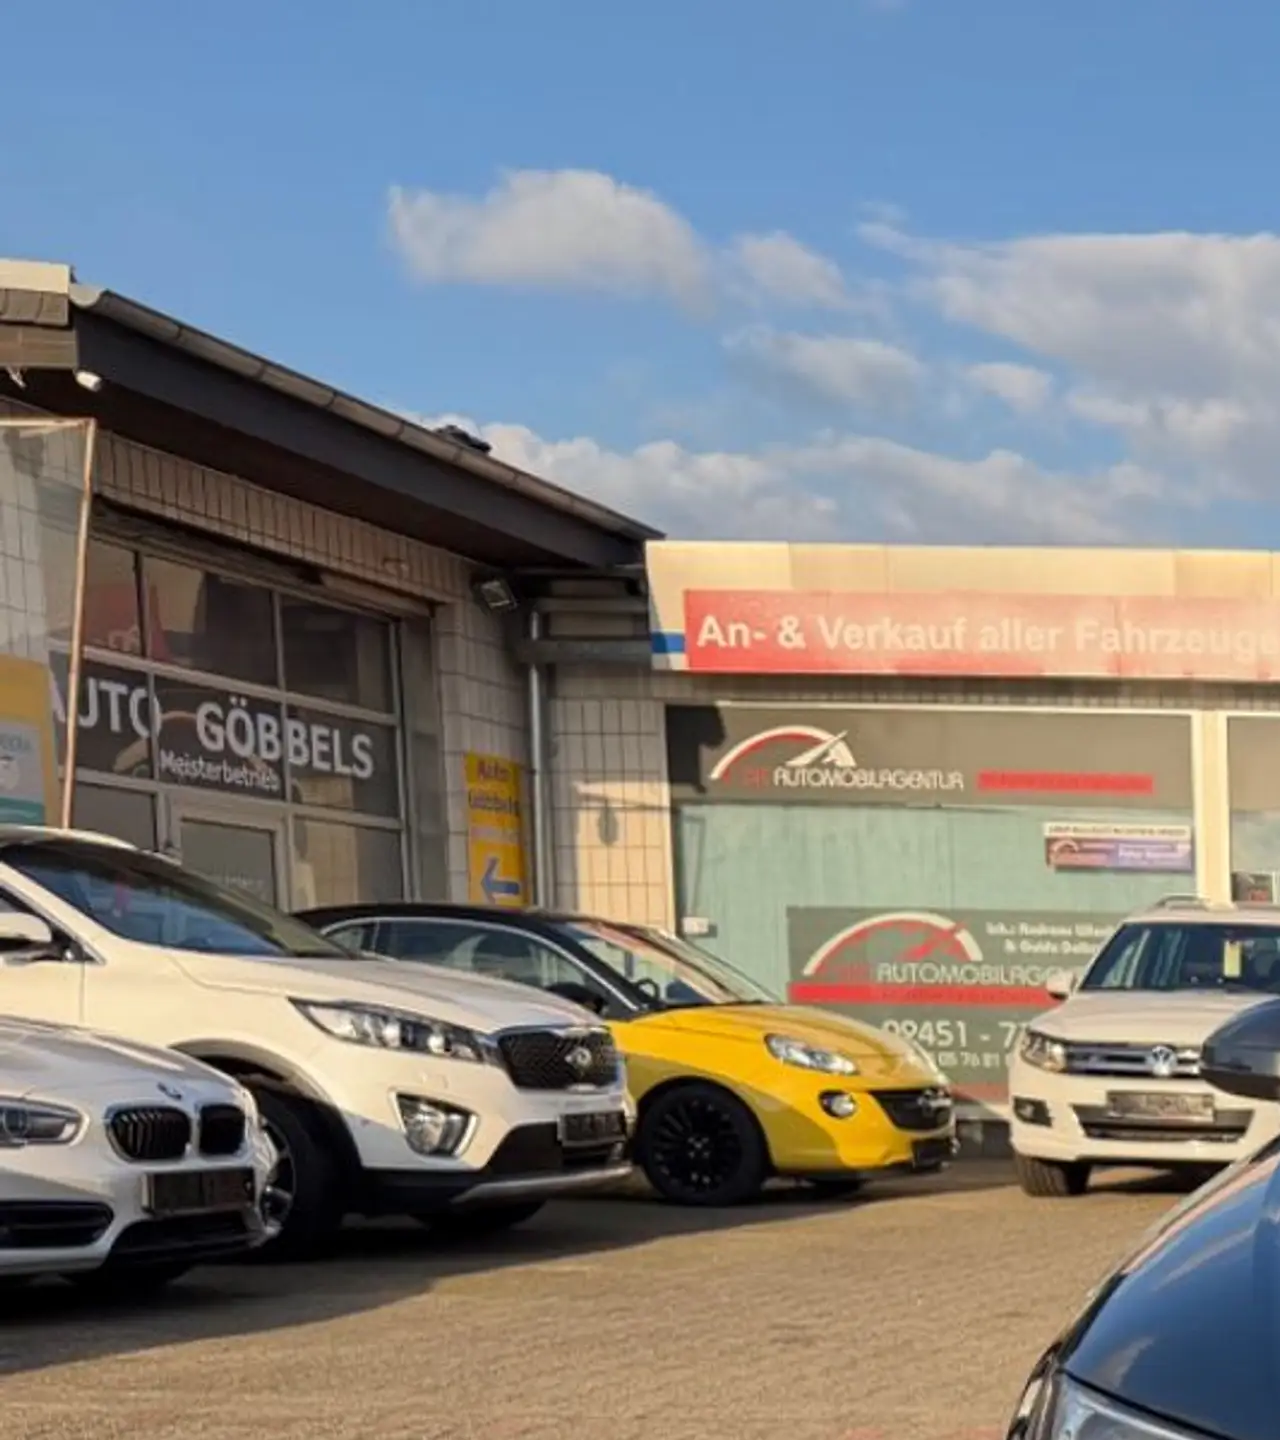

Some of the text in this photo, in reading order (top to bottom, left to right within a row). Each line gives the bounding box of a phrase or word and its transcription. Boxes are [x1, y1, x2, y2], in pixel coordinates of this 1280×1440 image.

[696, 615, 766, 651] An-
[778, 617, 806, 650] &
[819, 615, 967, 652] Verkauf
[980, 618, 1061, 654] aller
[195, 695, 375, 780] GÖBBELS
[159, 748, 282, 792] Meisterbetrieb
